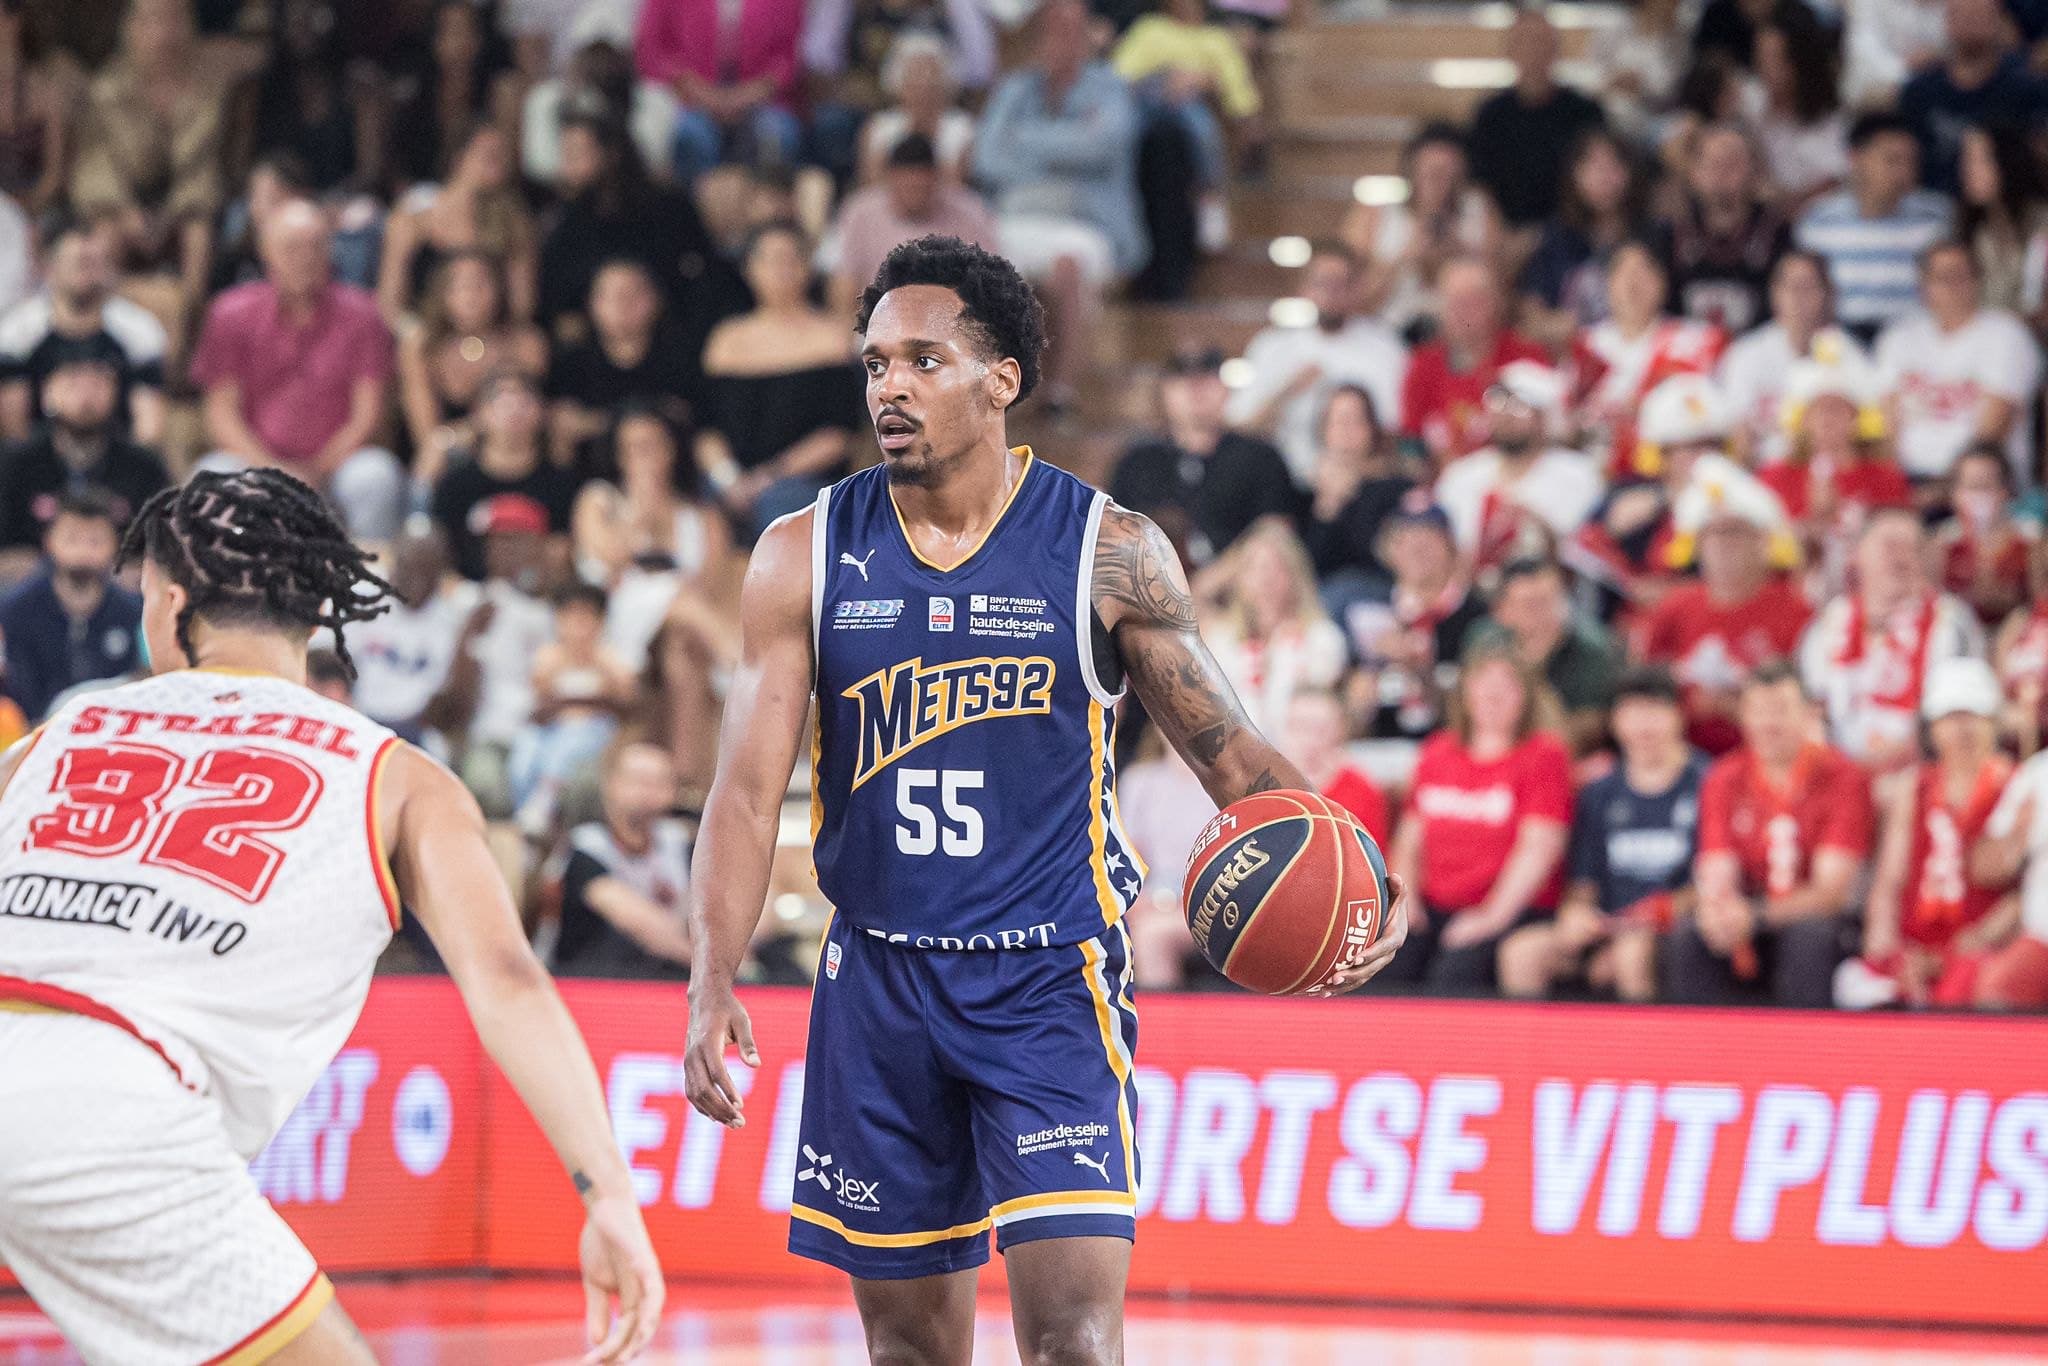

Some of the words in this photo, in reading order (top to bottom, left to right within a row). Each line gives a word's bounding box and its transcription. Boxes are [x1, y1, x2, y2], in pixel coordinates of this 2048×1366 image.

[989, 596, 1008, 604] BNP
[1009, 597, 1047, 607] PARIBAS
[1012, 606, 1044, 615] ESTATE
[969, 615, 1055, 633] hauts-de-seine
[1013, 630, 1038, 640] Sportif
[70, 706, 361, 760] STRAZEL
[896, 768, 984, 857] 55
[22, 741, 324, 904] 32
[1016, 1121, 1110, 1147] hauts-de-seine
[1067, 1137, 1094, 1147] Sportif
